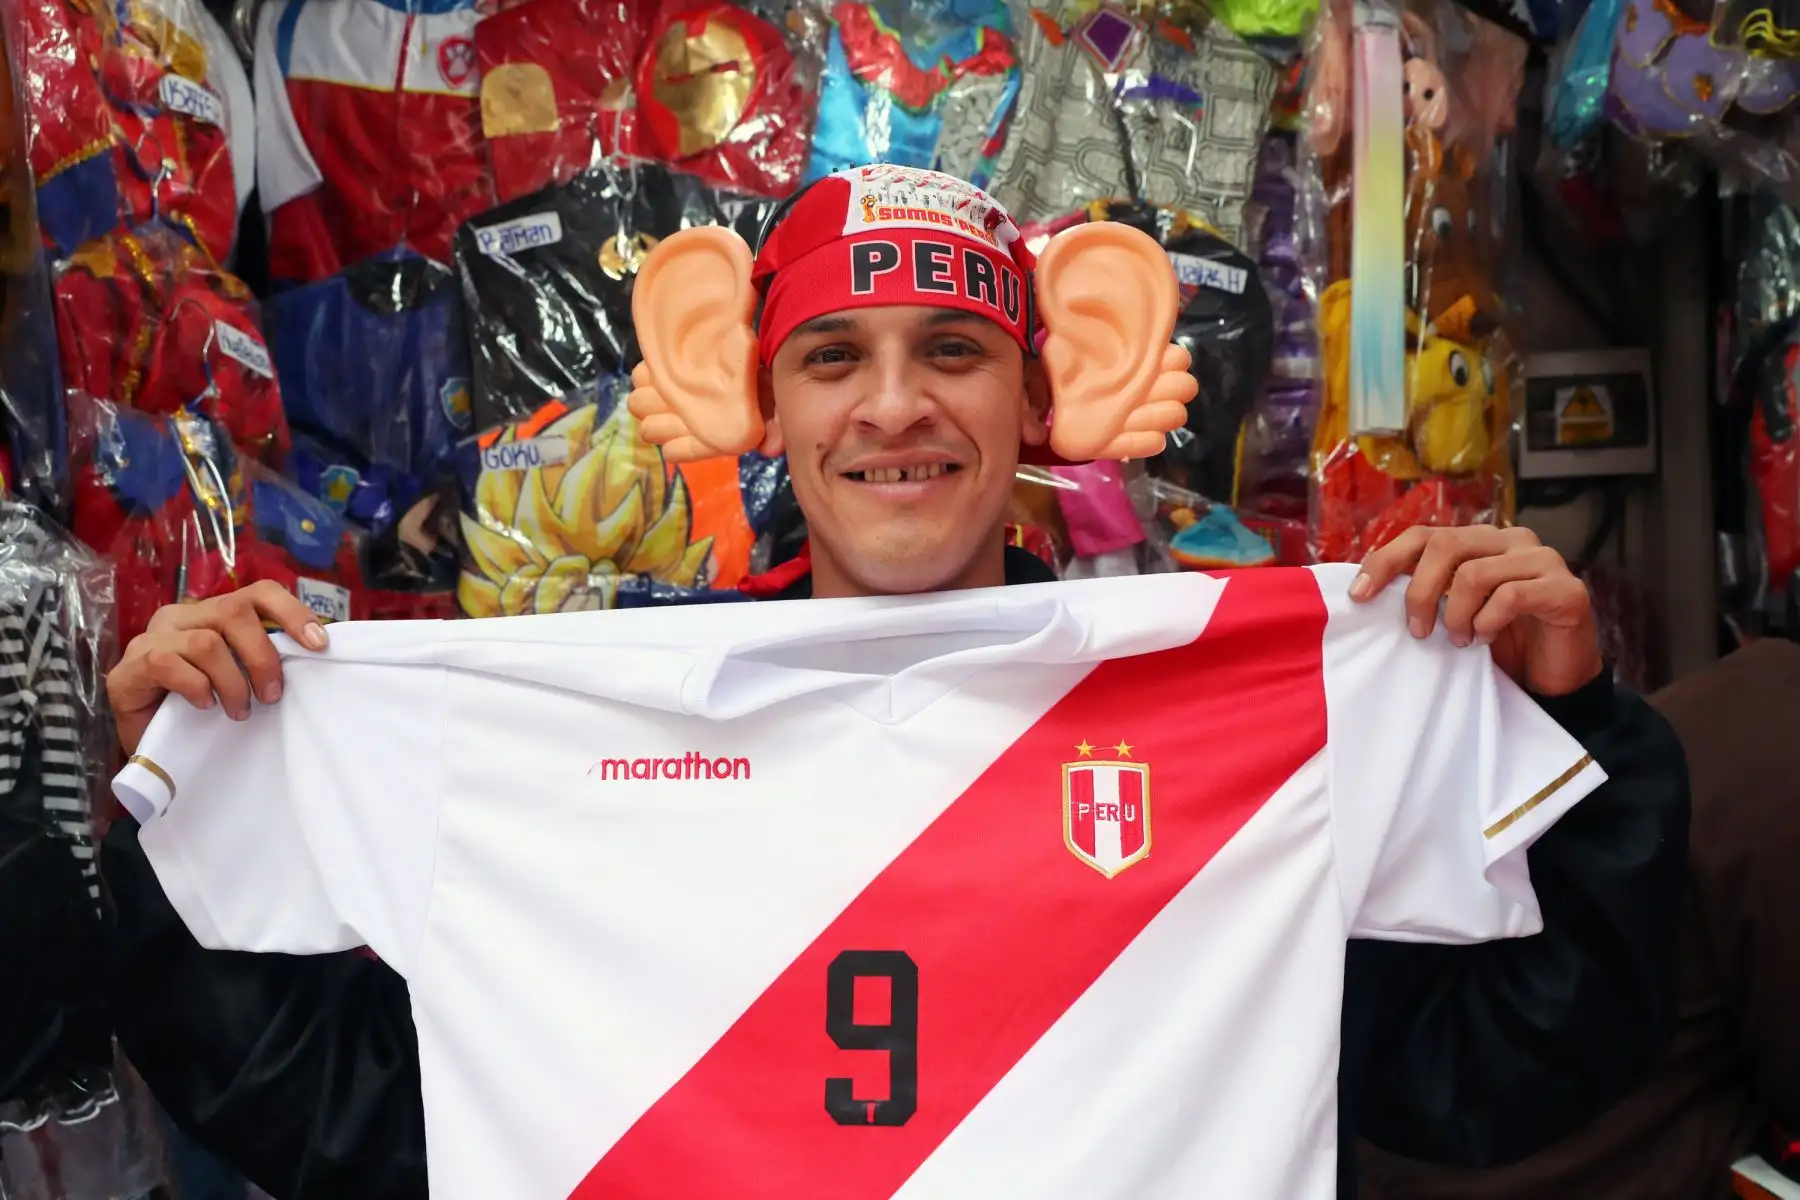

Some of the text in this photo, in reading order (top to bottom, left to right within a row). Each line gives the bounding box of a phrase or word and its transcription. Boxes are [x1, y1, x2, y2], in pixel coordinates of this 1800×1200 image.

[878, 206, 954, 227] SOMOS
[850, 240, 1020, 325] PERU
[485, 443, 540, 469] GOKU
[601, 751, 750, 780] marathon
[1078, 802, 1136, 822] PERU
[825, 950, 919, 1126] 9
